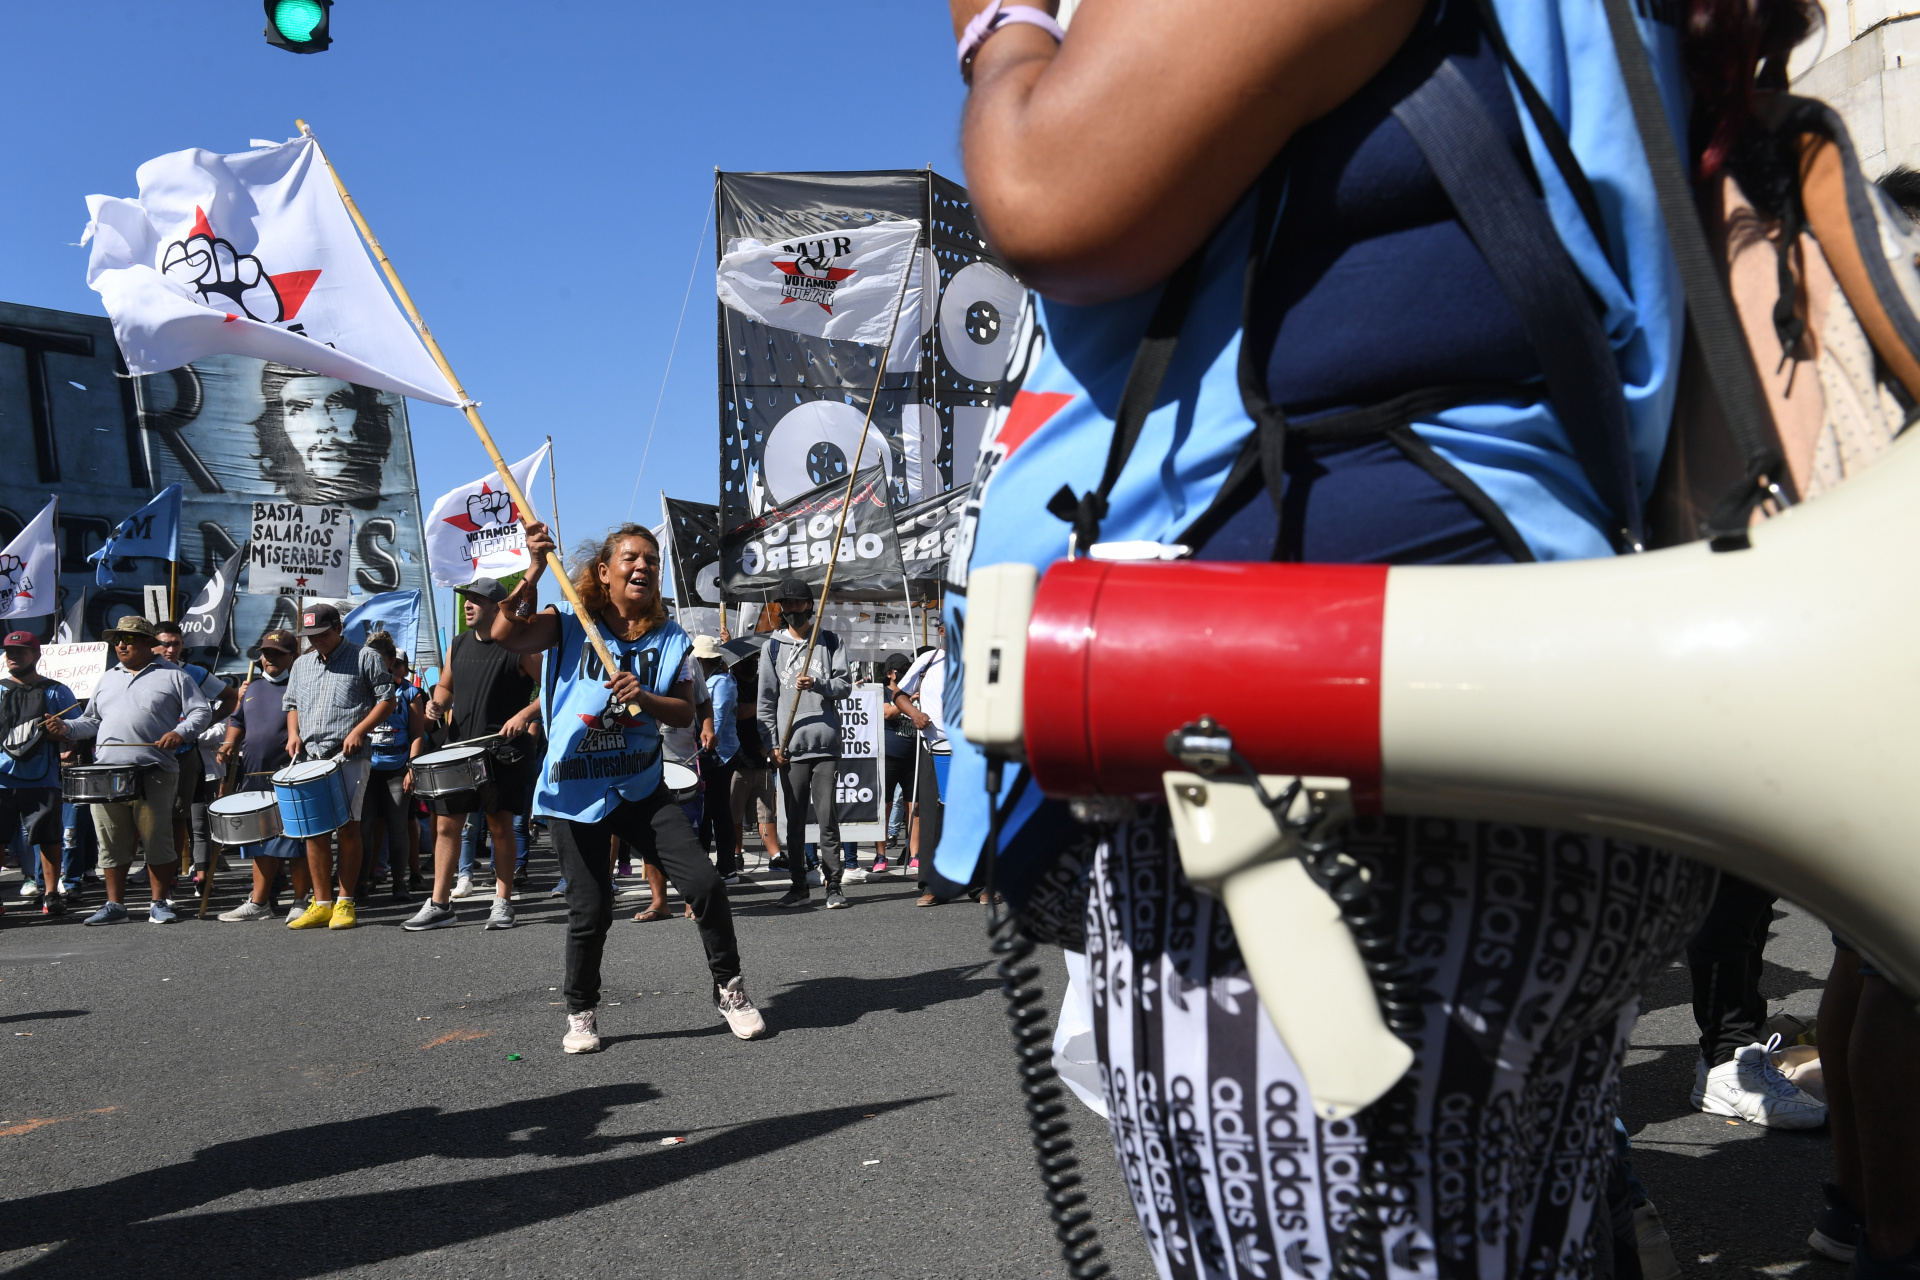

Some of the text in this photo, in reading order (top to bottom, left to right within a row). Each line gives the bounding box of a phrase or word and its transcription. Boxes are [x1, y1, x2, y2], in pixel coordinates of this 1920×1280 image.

[784, 274, 838, 290] VOTAMOS
[781, 285, 835, 307] LUCHAR
[253, 503, 343, 526] BASTA DE
[466, 524, 518, 543] VOTAMOS
[460, 533, 528, 562] LUCHAR
[281, 565, 324, 576] VOTAMOS
[280, 586, 318, 597] LUCHAR
[578, 641, 661, 688] MTR
[846, 698, 862, 711] DE
[1136, 1070, 1177, 1214] adidas
[1211, 1076, 1258, 1230] adidas
[1265, 1080, 1312, 1231] adidas
